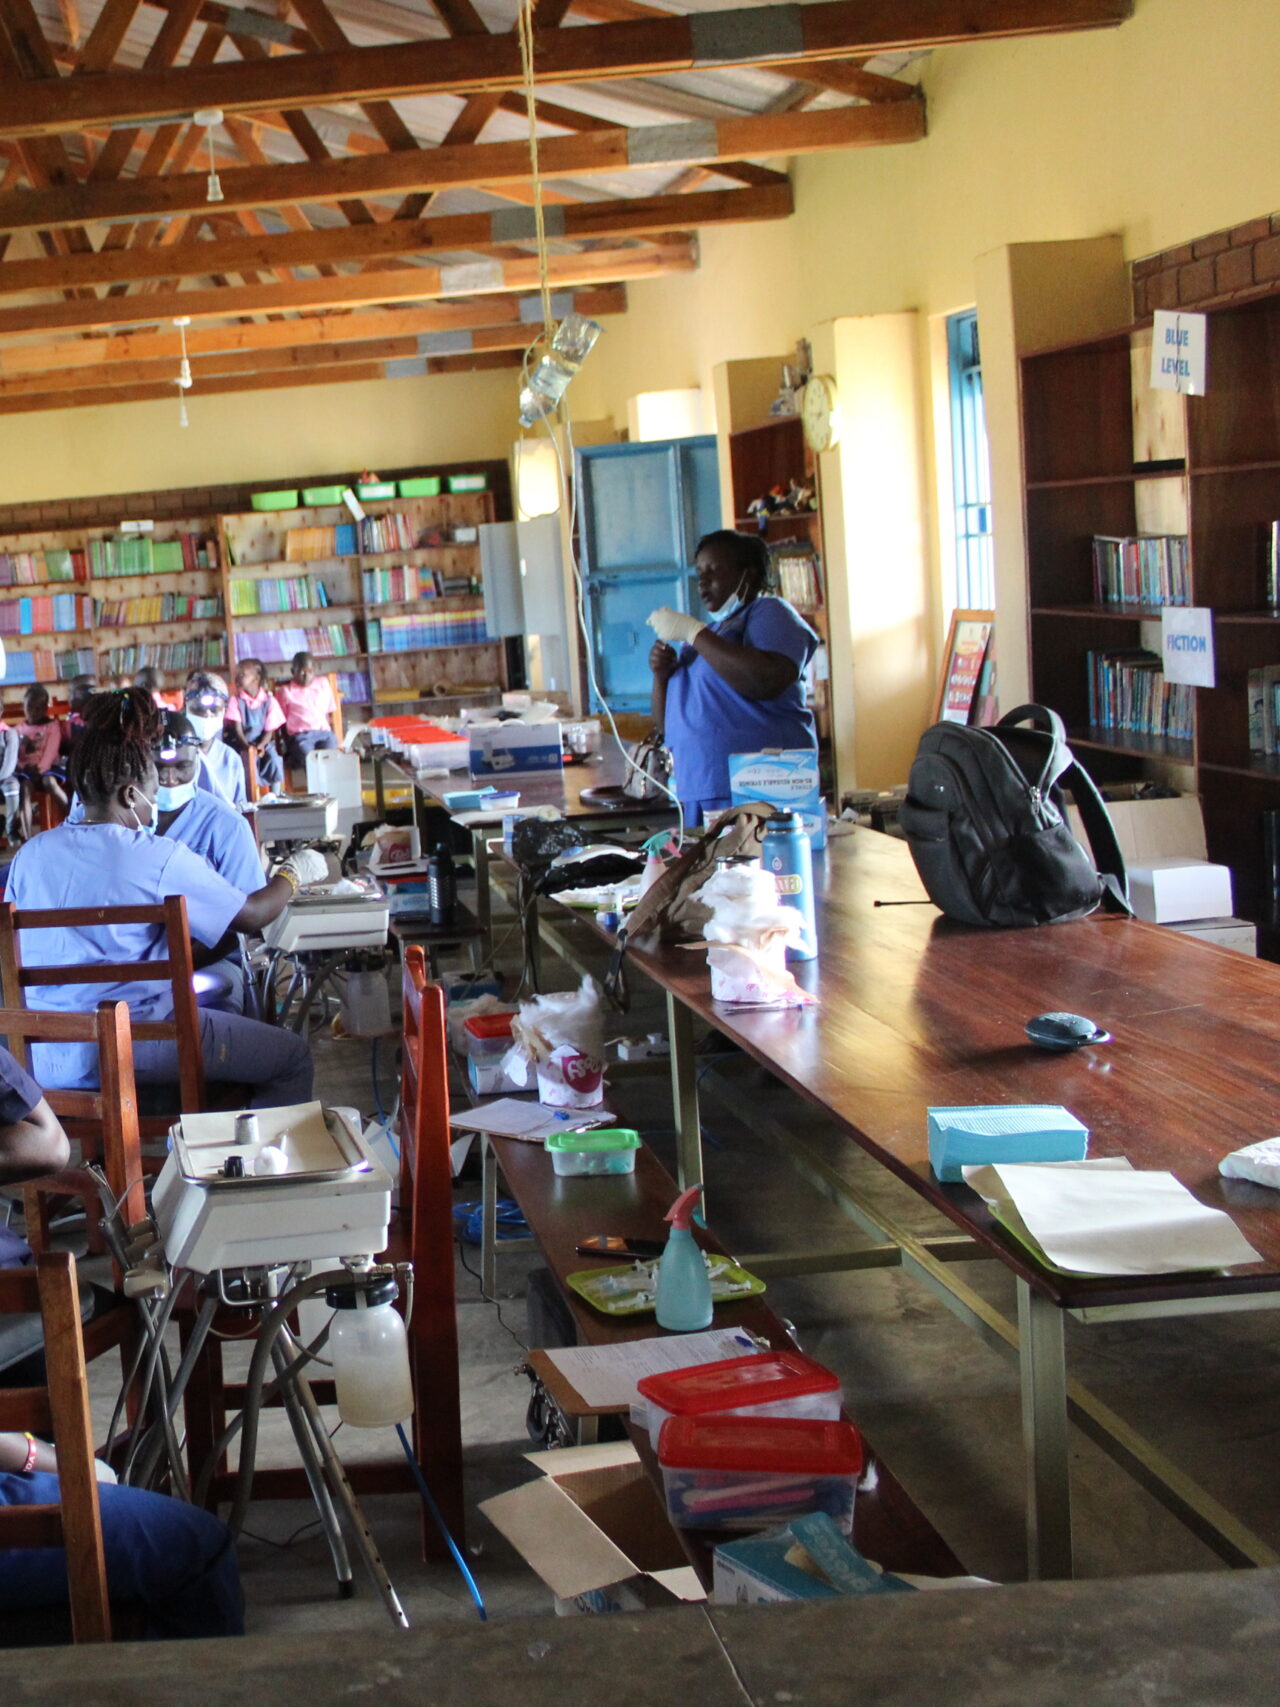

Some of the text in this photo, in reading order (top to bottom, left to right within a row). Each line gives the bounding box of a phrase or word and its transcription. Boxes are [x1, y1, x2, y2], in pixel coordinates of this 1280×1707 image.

[1165, 328, 1189, 347] BLUE
[1161, 357, 1191, 377] LEVEL
[1167, 634, 1207, 653] FICTION
